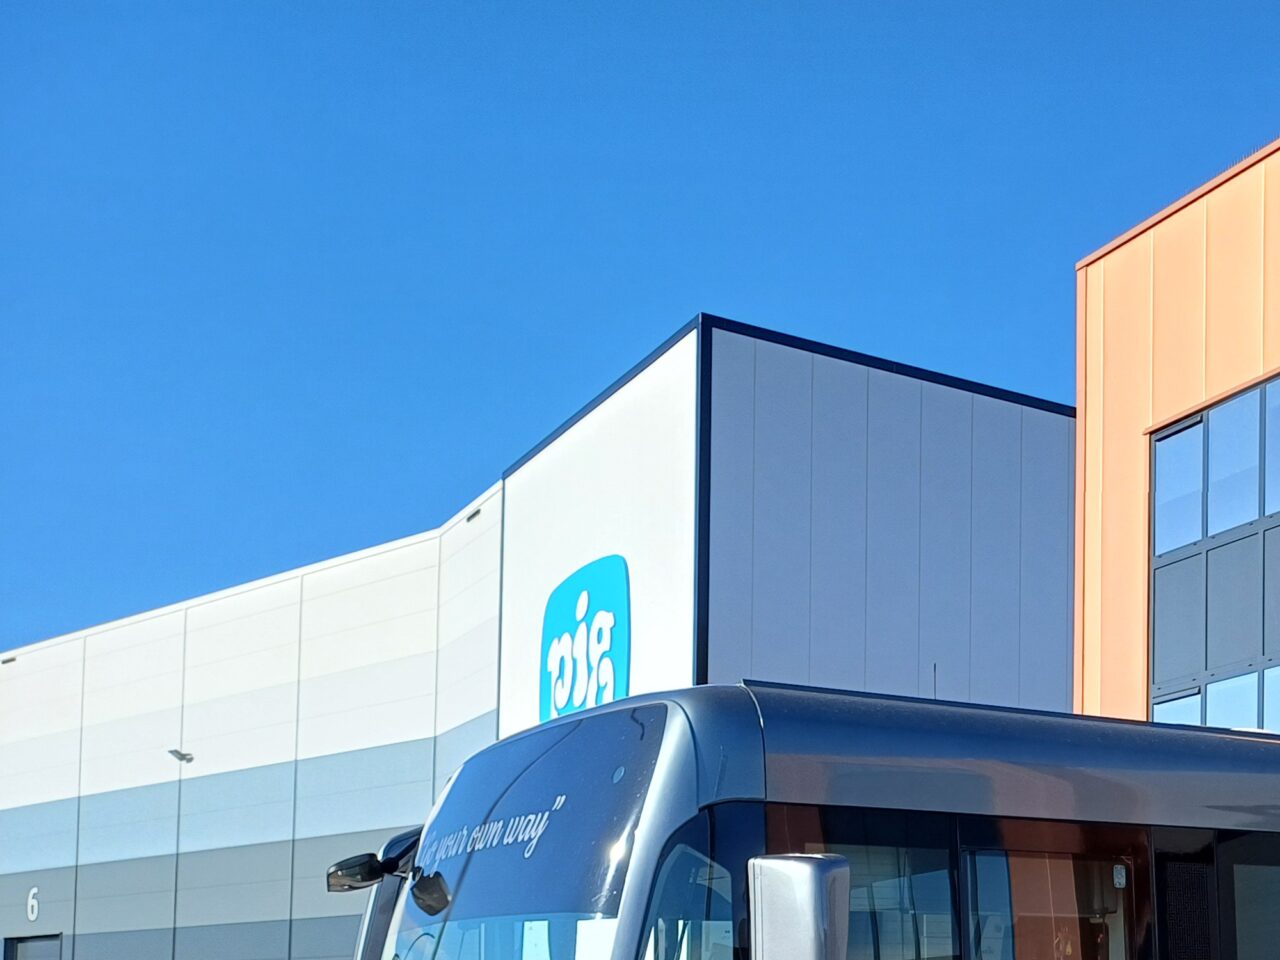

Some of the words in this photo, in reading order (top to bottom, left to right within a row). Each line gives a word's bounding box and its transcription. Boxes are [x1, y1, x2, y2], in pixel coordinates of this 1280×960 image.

[436, 825, 468, 877] your
[468, 819, 504, 852] own
[27, 887, 39, 921] 6
